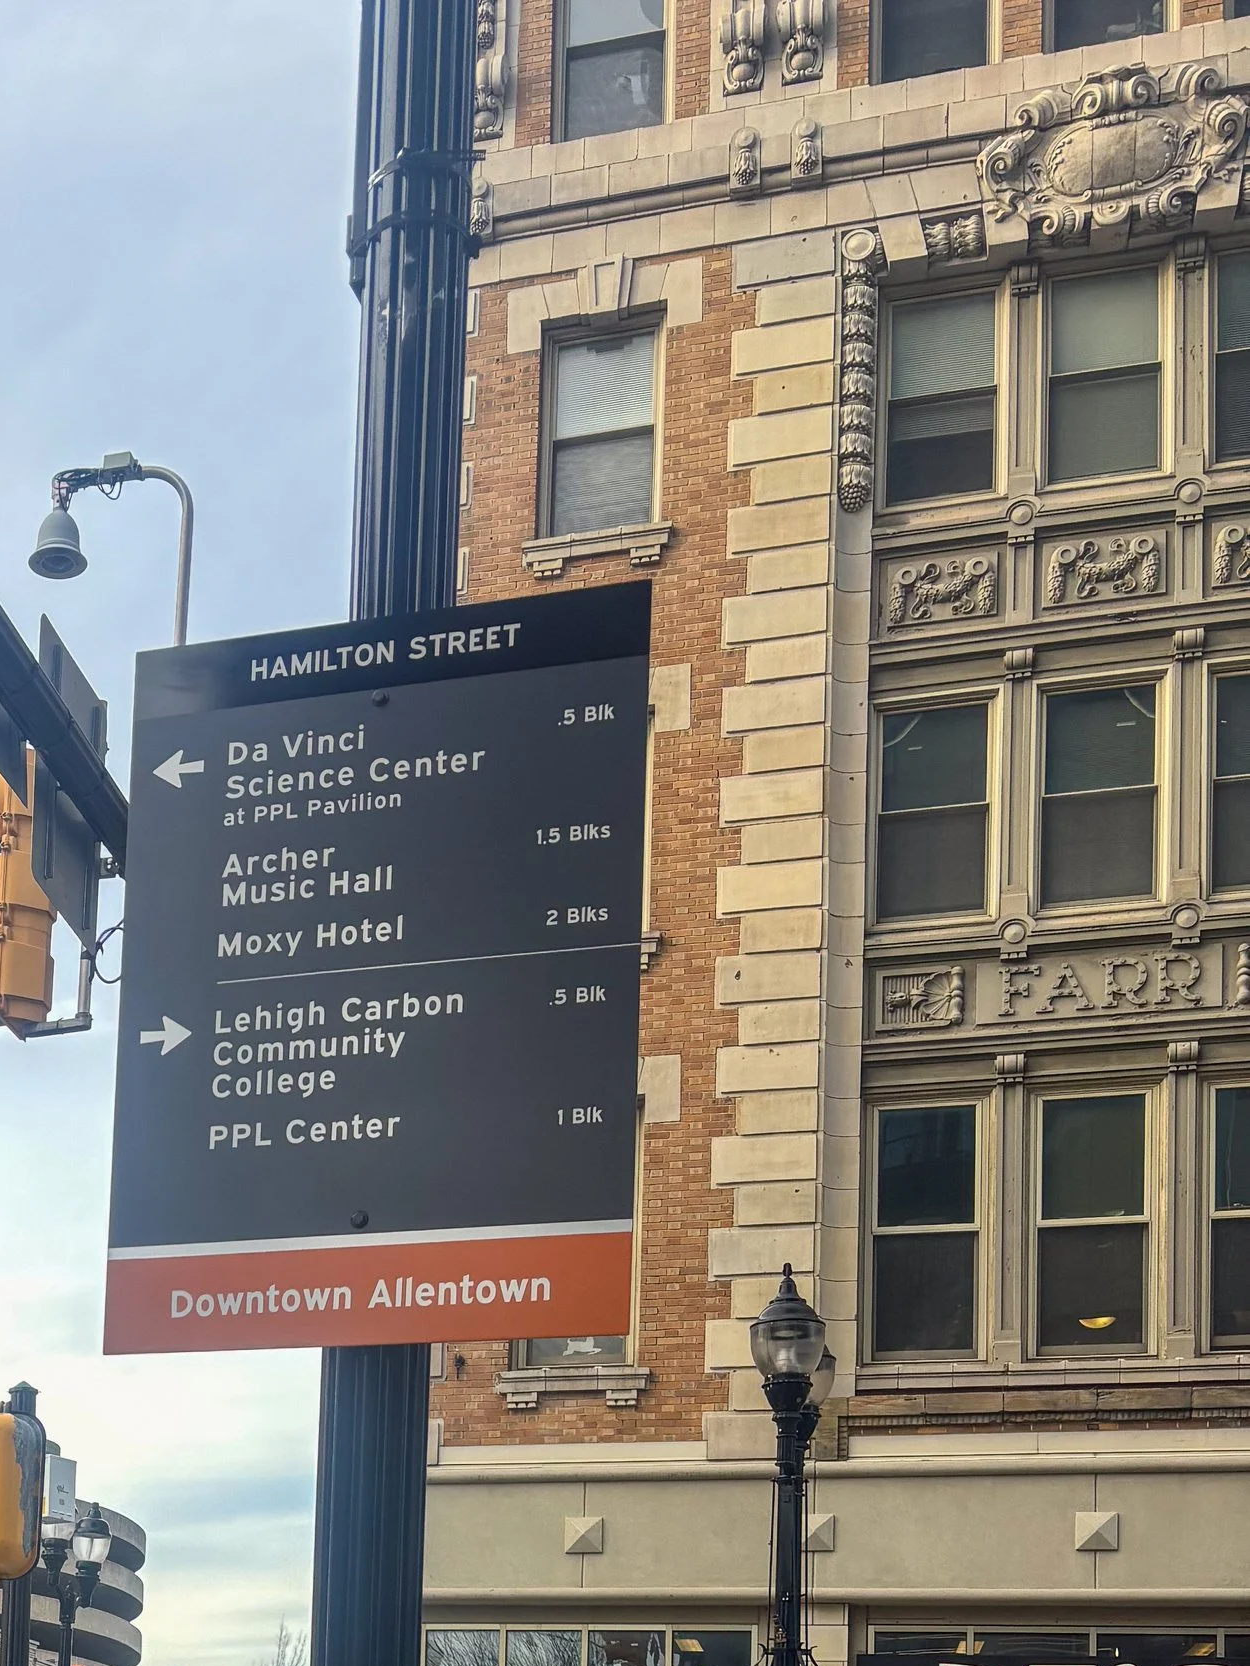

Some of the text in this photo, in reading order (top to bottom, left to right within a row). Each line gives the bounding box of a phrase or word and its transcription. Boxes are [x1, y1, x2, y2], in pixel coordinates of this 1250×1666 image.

[251, 623, 522, 682] HAMILTON STREET
[557, 703, 615, 726] .5 Blk
[227, 725, 366, 766] Da Vinci
[226, 750, 486, 800] Science Center
[223, 790, 402, 827] at PPL Pavilion
[536, 823, 611, 845] 1.5 Blks
[222, 847, 336, 878] Archer
[222, 865, 393, 907] Music Hall
[546, 905, 609, 926] 2 Blks
[217, 915, 404, 958] Moxy Hotel
[549, 985, 607, 1006] .5 Blk
[998, 951, 1202, 1016] FARR
[214, 989, 464, 1035] Lehigh Carbon
[213, 1028, 405, 1066] Community
[212, 1067, 336, 1099] College
[208, 1112, 401, 1150] PPL Center
[556, 1106, 603, 1126] 1 Blk
[170, 1275, 551, 1319] Downtown Allentown
